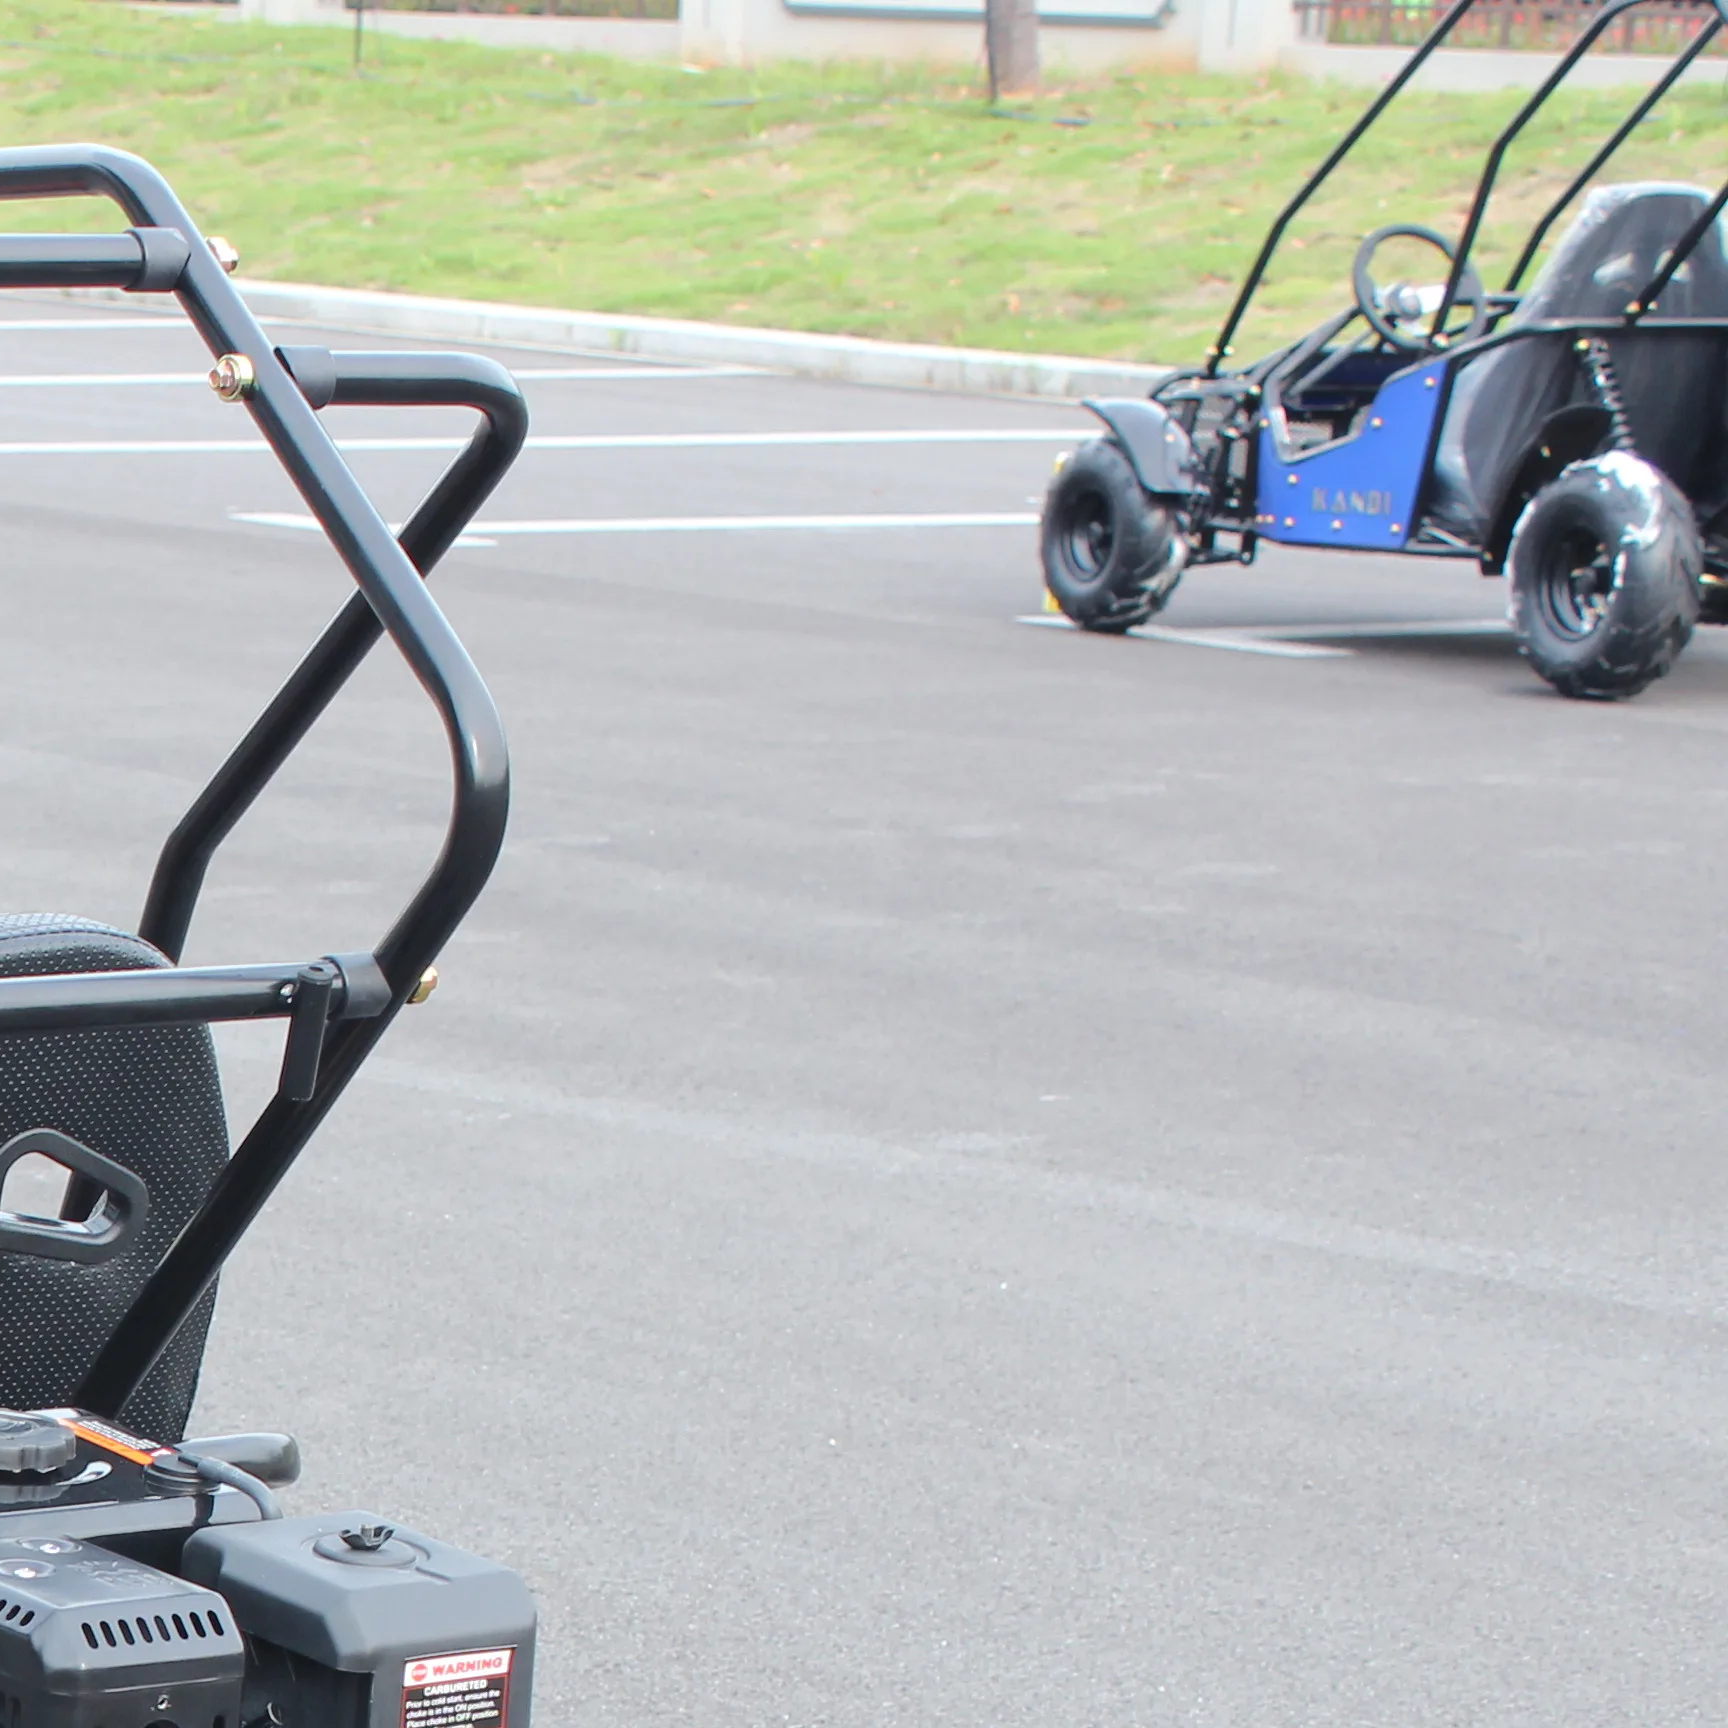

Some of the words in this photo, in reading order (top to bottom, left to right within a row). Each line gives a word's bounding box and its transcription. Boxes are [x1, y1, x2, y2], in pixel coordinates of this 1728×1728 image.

[1312, 487, 1392, 515] KANDI
[432, 1657, 503, 1675] WARNING
[424, 1679, 488, 1697] CARBURETED
[405, 1701, 422, 1710] Prior
[423, 1699, 430, 1707] to
[431, 1697, 446, 1706] cold
[464, 1691, 488, 1701] ensure
[489, 1689, 500, 1698] the
[406, 1710, 427, 1720] choke
[428, 1708, 434, 1716] is
[435, 1707, 442, 1715] in
[442, 1706, 454, 1714] the
[455, 1703, 467, 1712] ON
[426, 1717, 447, 1727] choke
[448, 1715, 455, 1723] in
[455, 1712, 471, 1722] OFF
